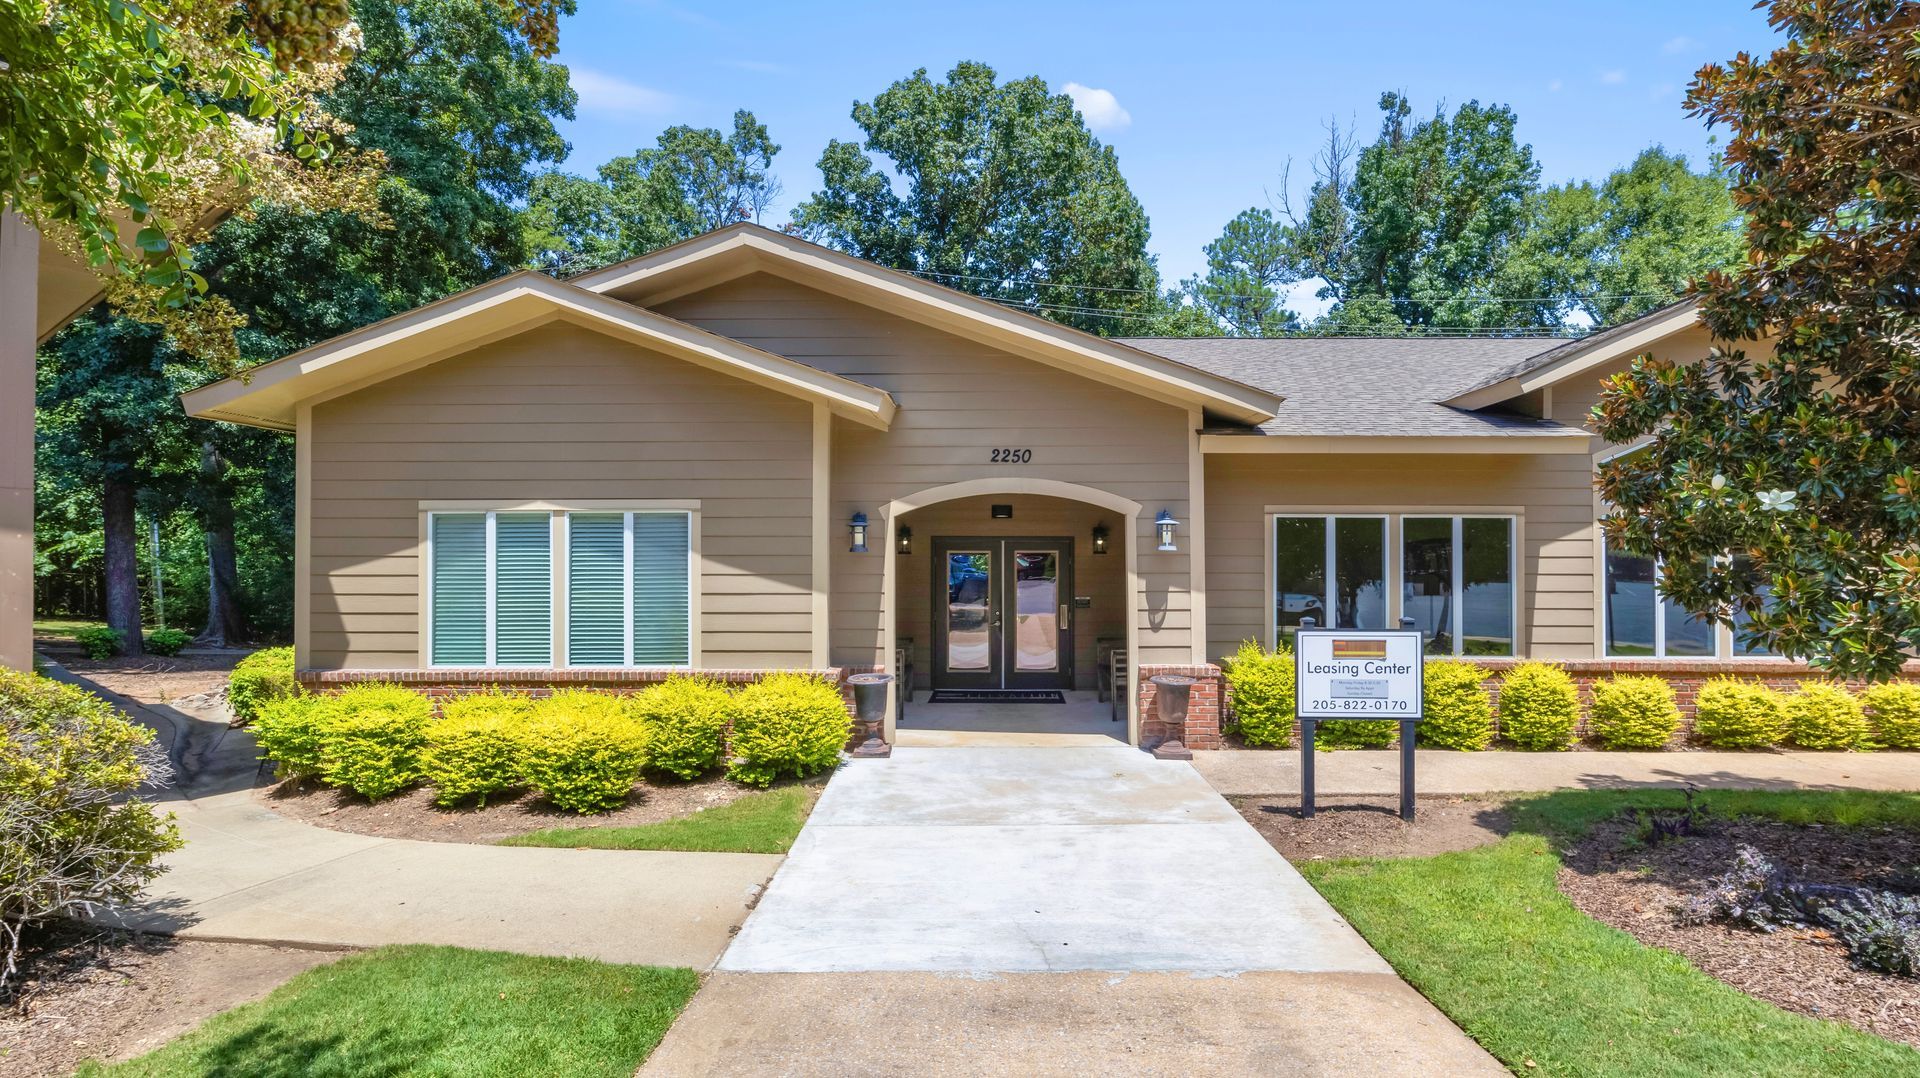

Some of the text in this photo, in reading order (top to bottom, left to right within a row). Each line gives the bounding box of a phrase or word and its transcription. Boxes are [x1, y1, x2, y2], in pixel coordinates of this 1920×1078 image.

[990, 448, 1032, 463] 2250
[1307, 661, 1412, 677] Leasing Center
[1312, 700, 1408, 710] 205-822-0170
